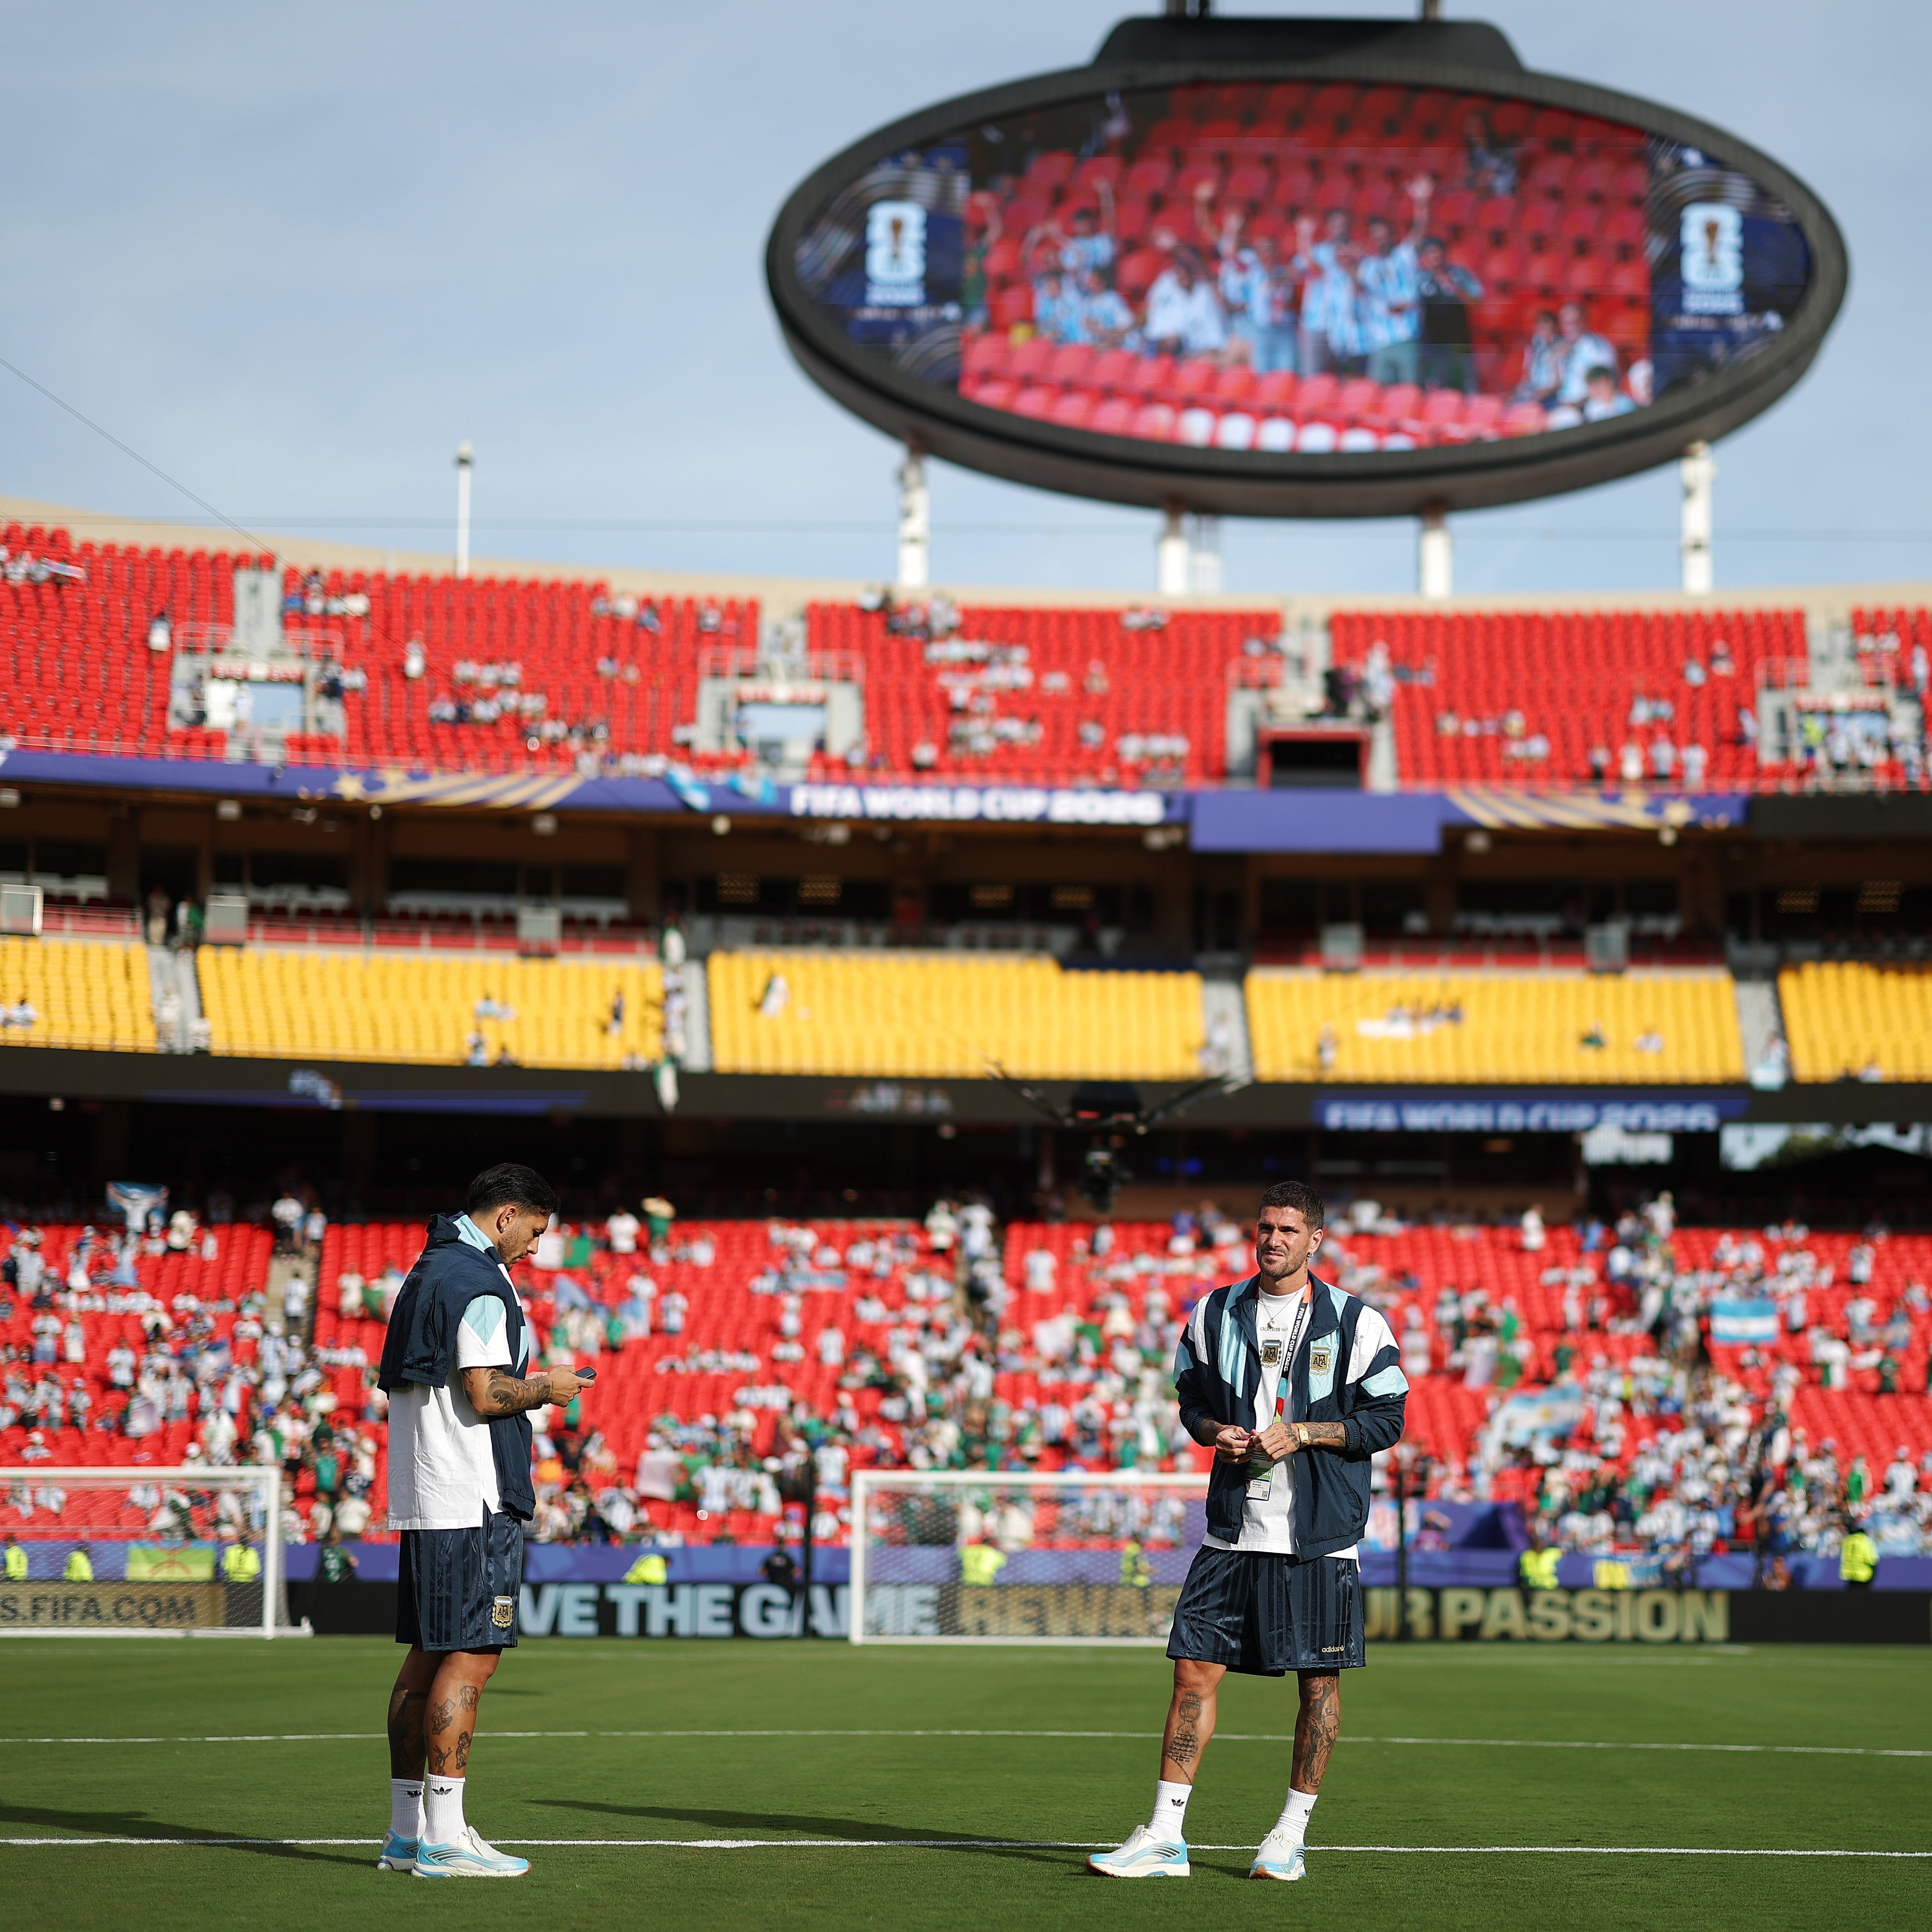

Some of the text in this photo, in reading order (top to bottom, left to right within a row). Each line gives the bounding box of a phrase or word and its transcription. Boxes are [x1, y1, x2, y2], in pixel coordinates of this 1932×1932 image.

[791, 786, 862, 817] FIFA
[864, 787, 979, 819] WORLD
[982, 789, 1046, 820] CUP
[1325, 1101, 1399, 1131] FIFA
[1400, 1101, 1524, 1132] WORLD
[1526, 1101, 1596, 1132] CUP
[1291, 1318, 1302, 1341] WORLD
[1296, 1307, 1305, 1320] FIFA
[605, 1583, 735, 1637] THE
[739, 1583, 940, 1638] GAME
[1439, 1586, 1729, 1640] PASSION
